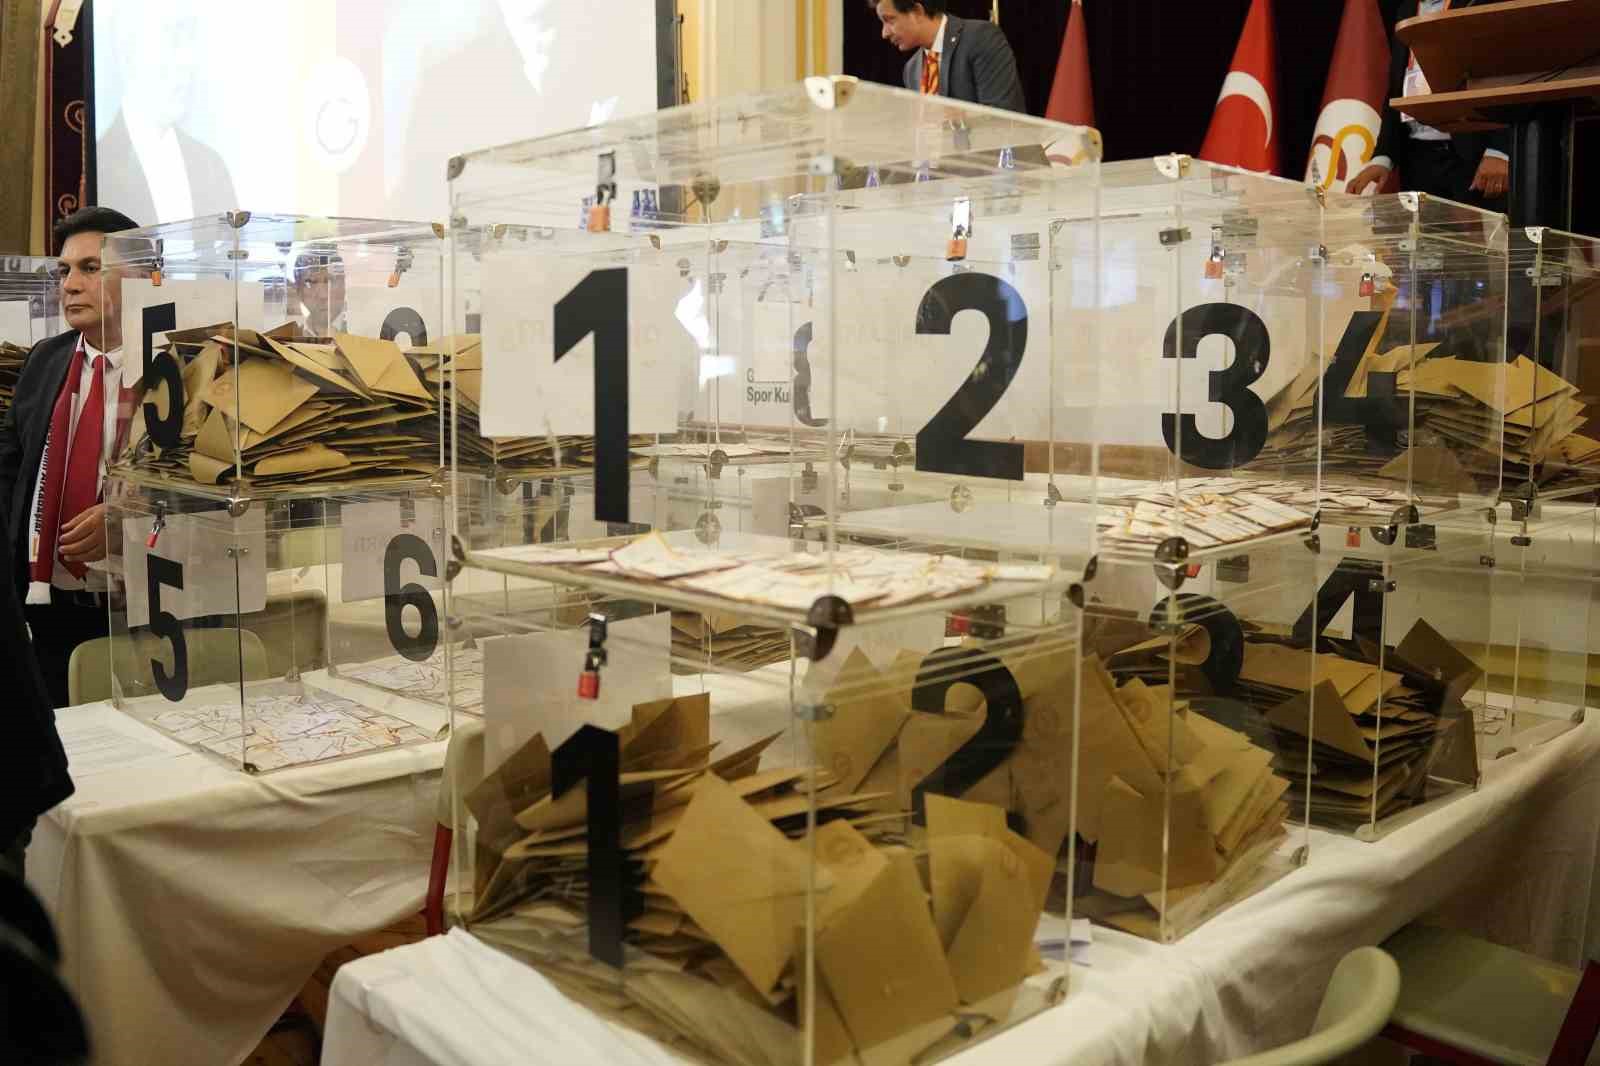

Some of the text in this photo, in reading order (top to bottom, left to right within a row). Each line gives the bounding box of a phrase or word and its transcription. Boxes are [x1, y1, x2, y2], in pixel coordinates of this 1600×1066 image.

[142, 302, 185, 449] 5
[553, 268, 629, 523] 1
[746, 386, 772, 405] Spor
[915, 272, 1028, 480] 2
[1161, 302, 1271, 470] 3
[1314, 311, 1409, 453] 4
[147, 553, 188, 702] 5
[383, 533, 439, 662] 6
[911, 645, 1026, 828] 2
[551, 723, 623, 968] 1
